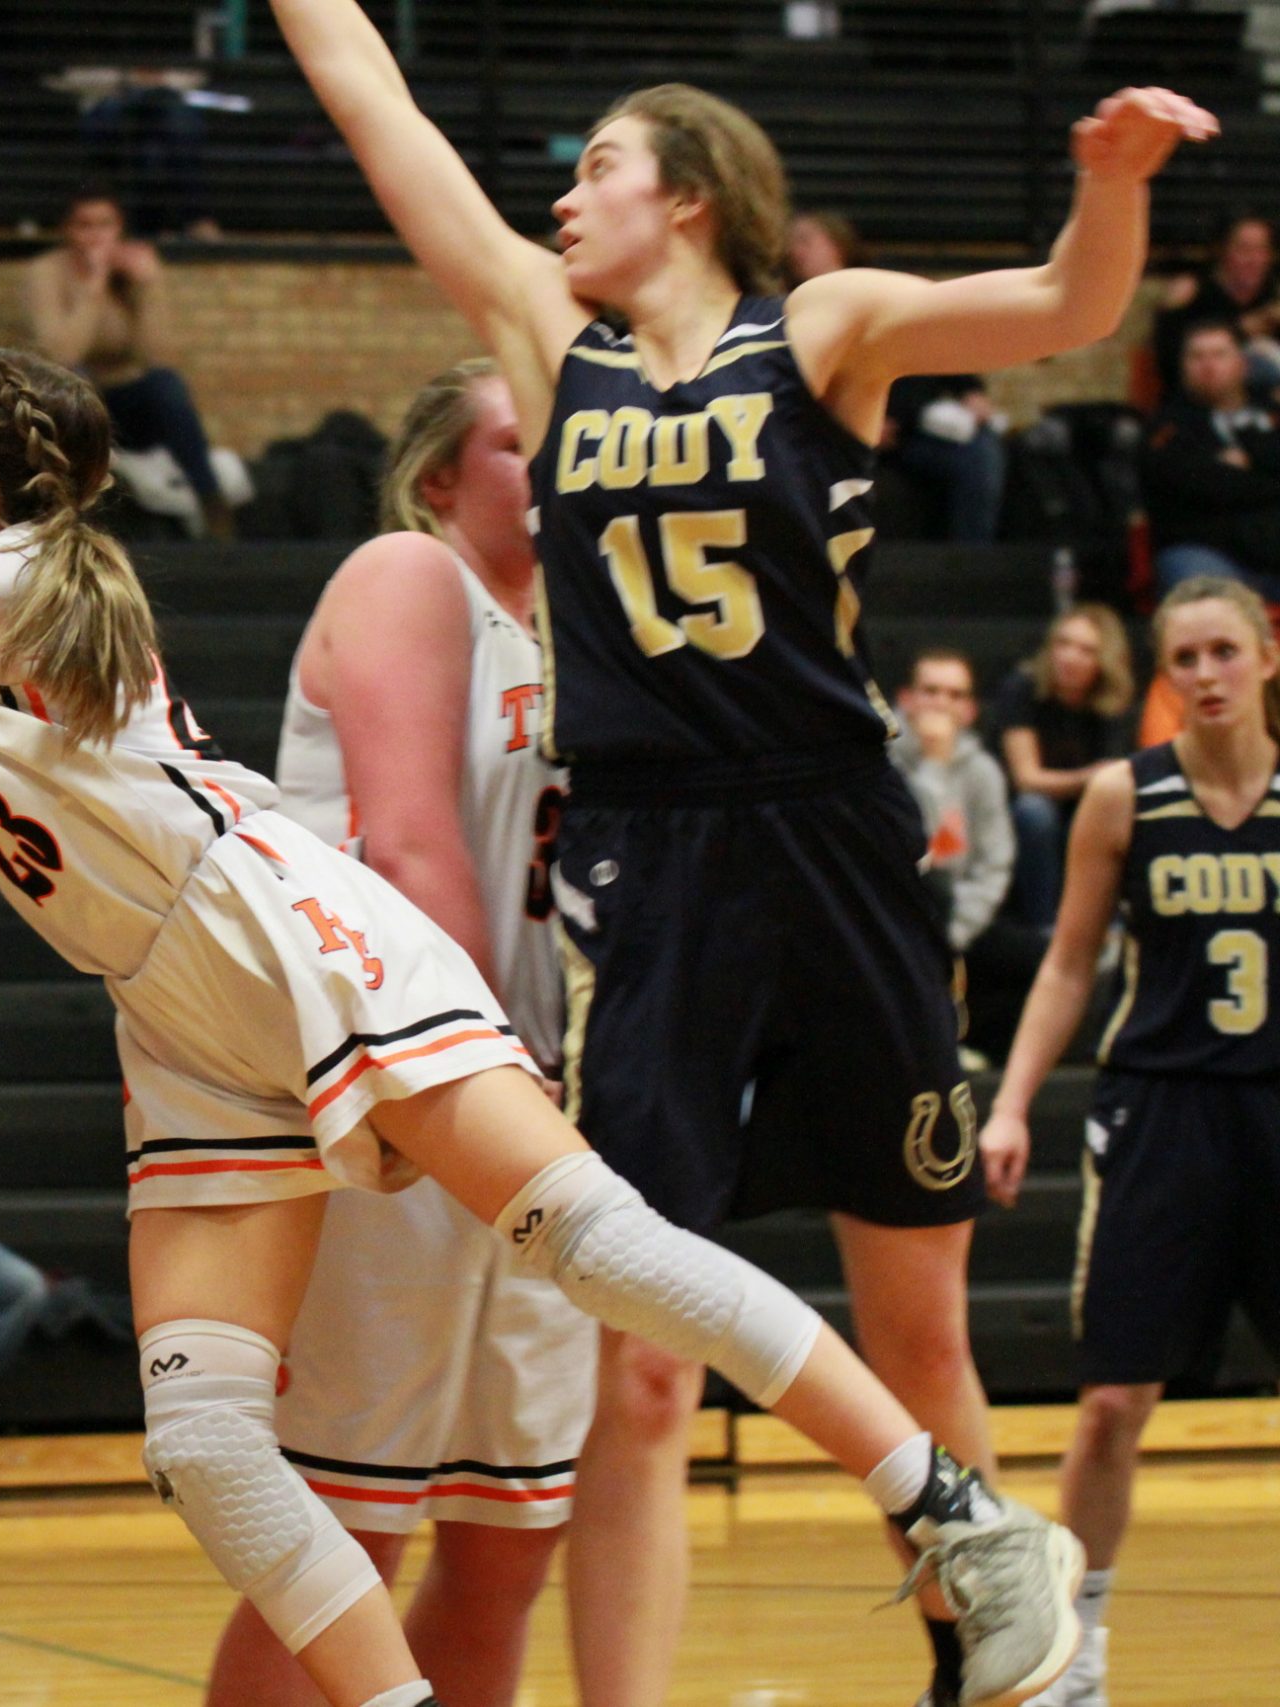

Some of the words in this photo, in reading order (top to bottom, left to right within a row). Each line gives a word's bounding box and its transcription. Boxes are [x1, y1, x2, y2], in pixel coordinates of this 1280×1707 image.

[555, 392, 773, 494] CODY
[598, 509, 765, 660] 15
[1207, 929, 1268, 1035] 3
